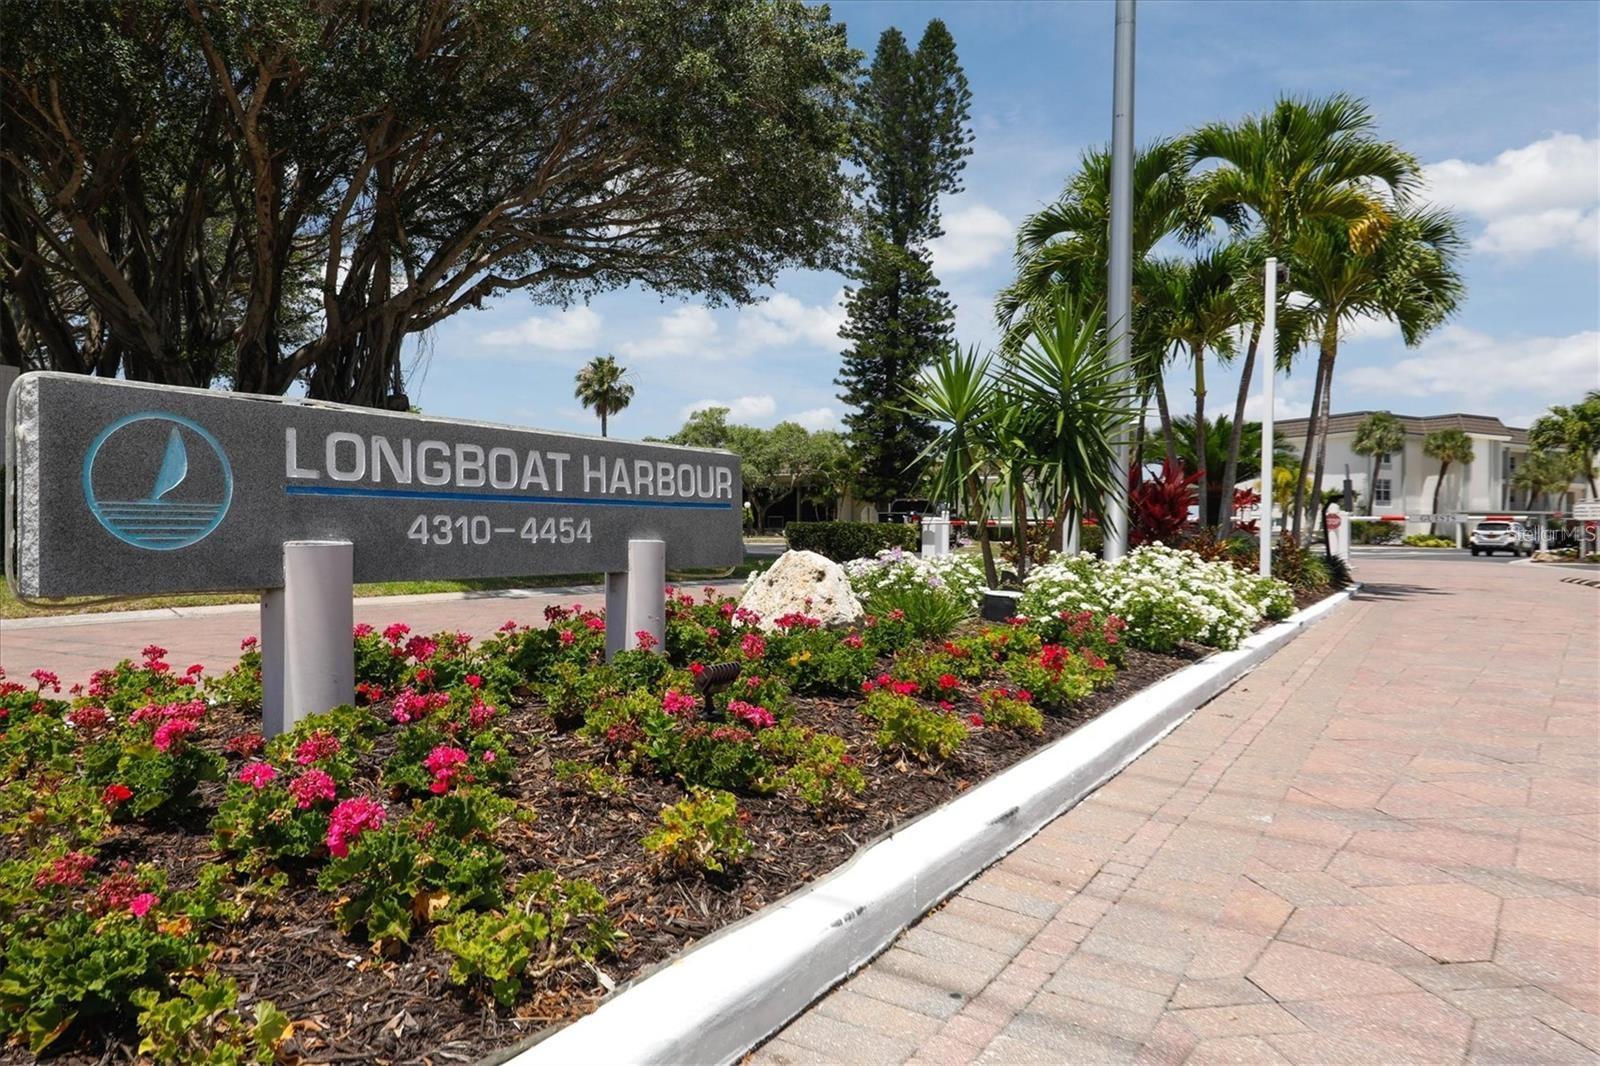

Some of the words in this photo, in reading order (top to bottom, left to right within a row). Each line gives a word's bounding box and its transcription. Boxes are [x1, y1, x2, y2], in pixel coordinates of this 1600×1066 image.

[285, 427, 570, 492] LONGBOAT
[583, 455, 733, 498] HARBOUR
[407, 514, 593, 545] 4310-4454
